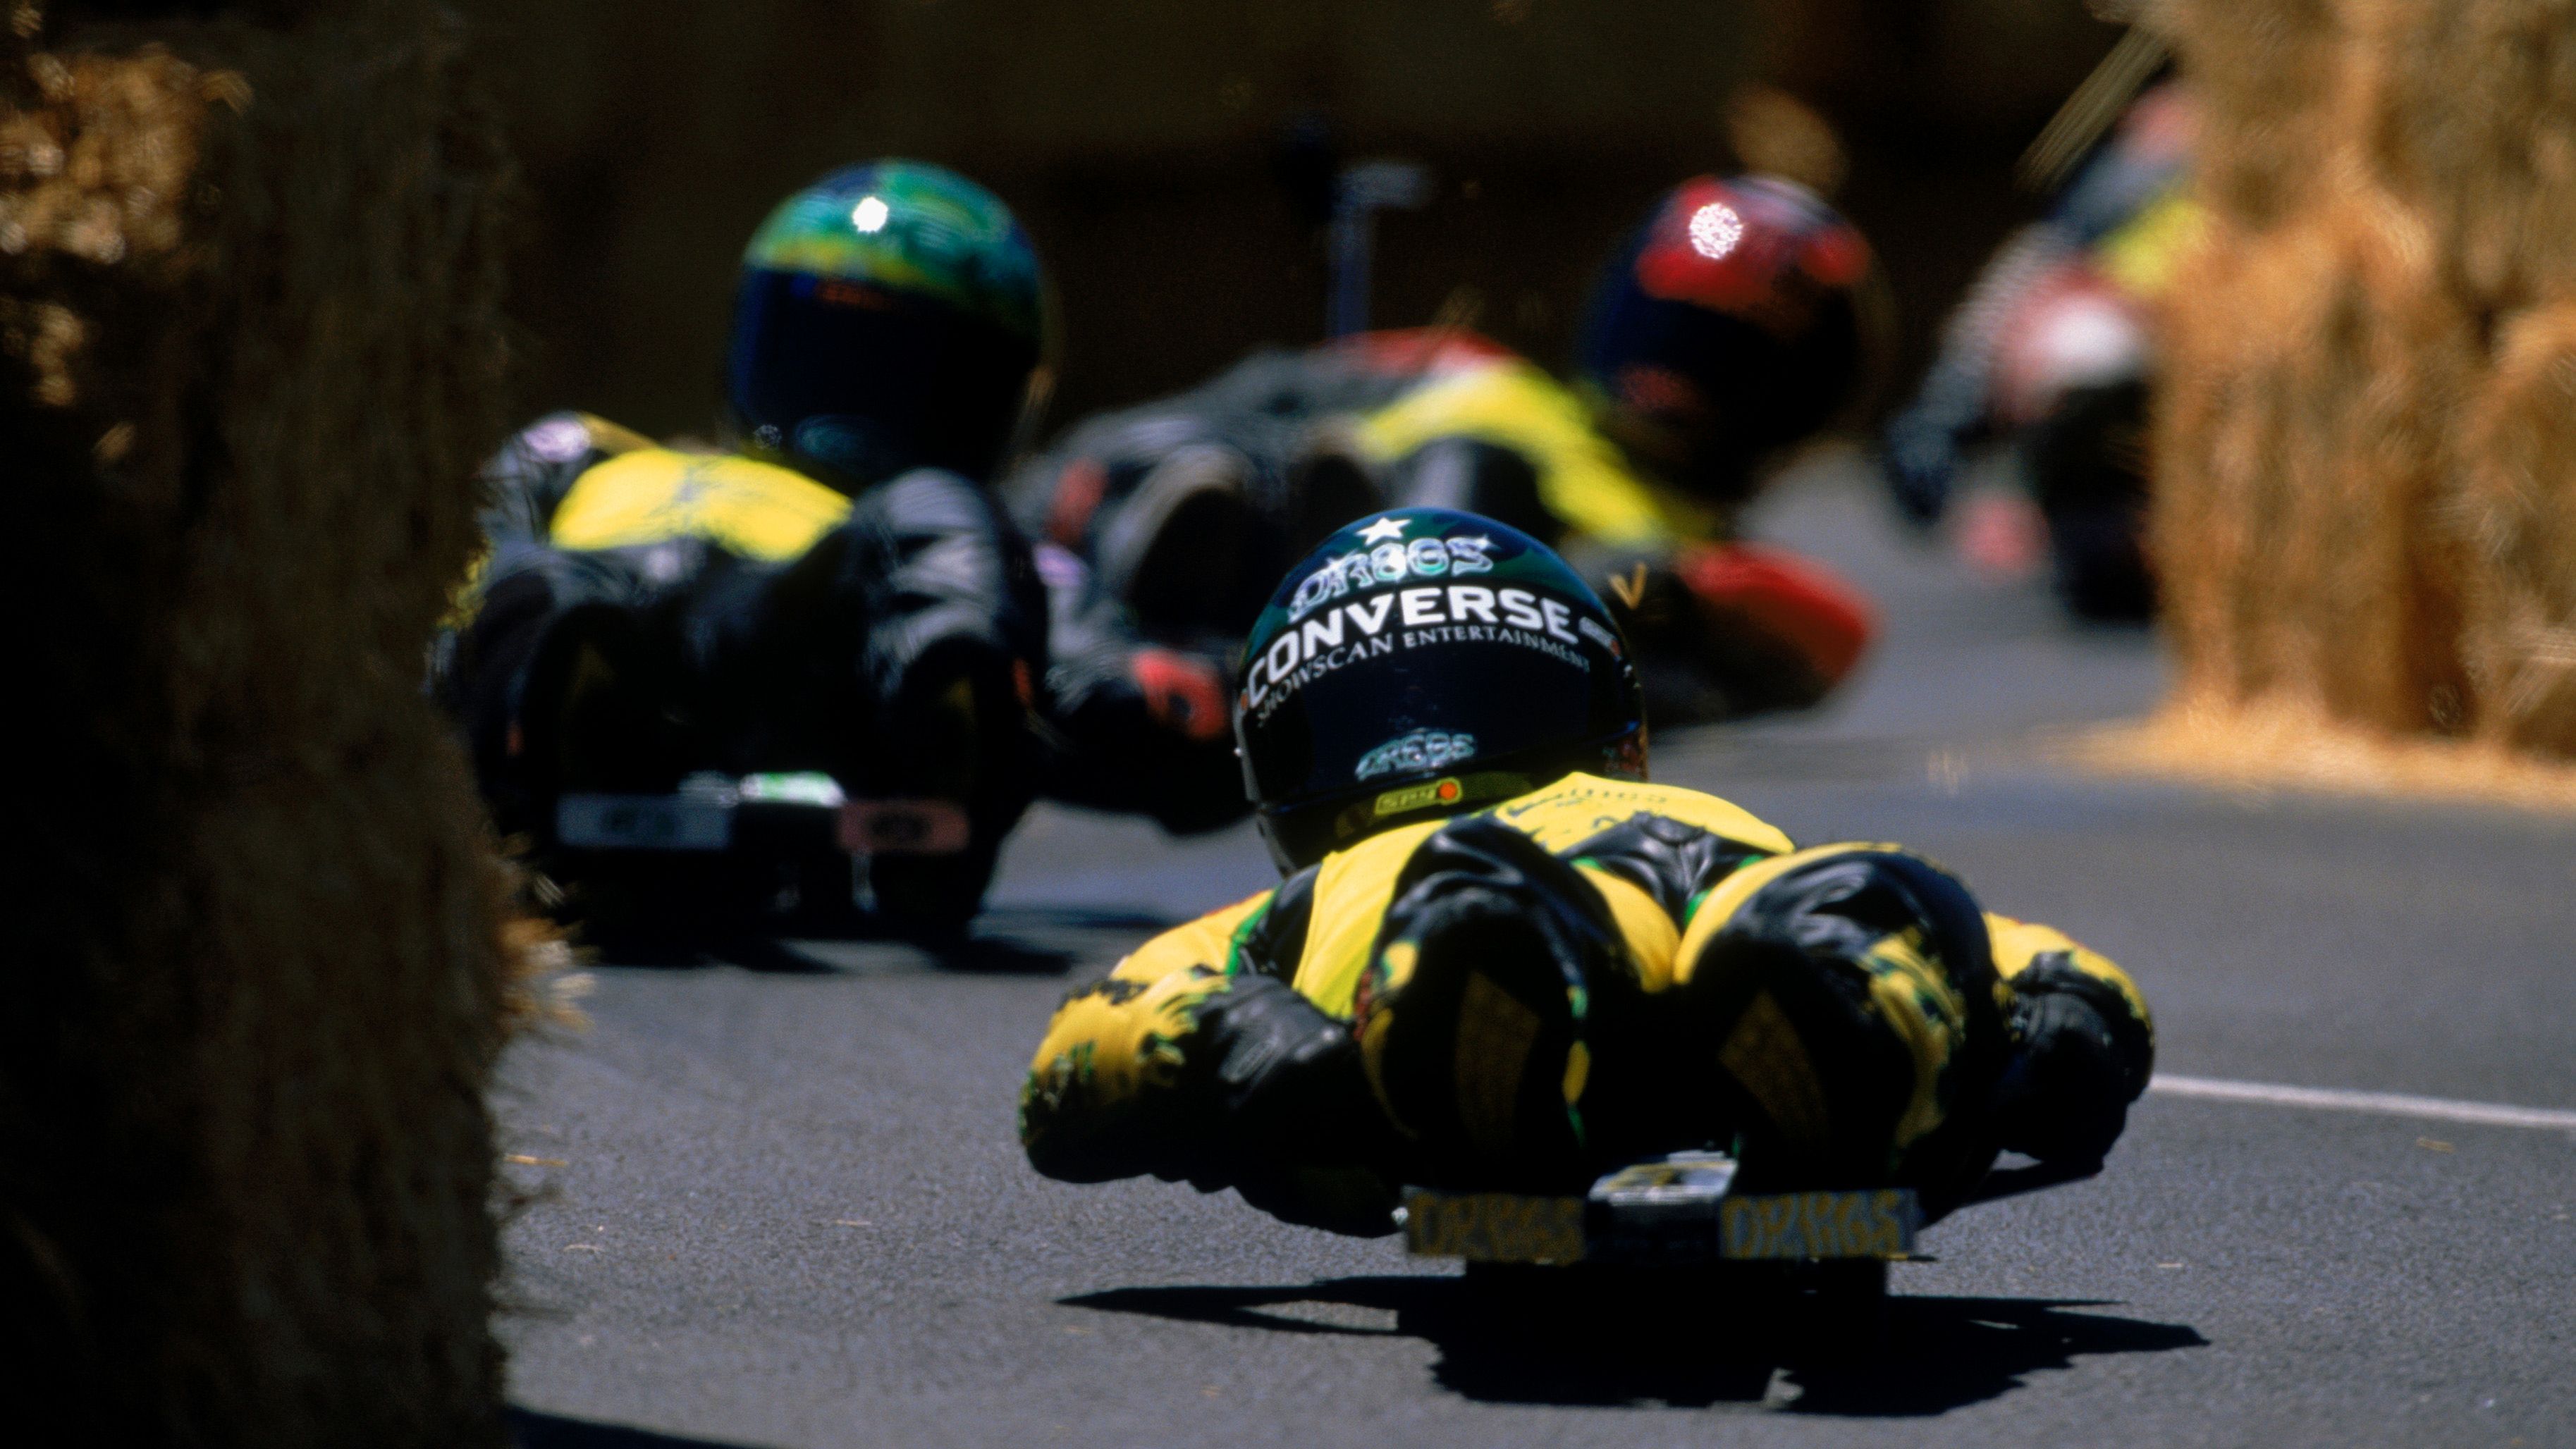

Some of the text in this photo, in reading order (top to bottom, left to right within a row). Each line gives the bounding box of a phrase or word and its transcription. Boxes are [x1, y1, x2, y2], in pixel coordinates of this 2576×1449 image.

[1247, 586, 1578, 708] CONVERSE
[1258, 631, 1394, 728] SHOWSCAN
[1403, 625, 1590, 673] ENTERTAINMENT
